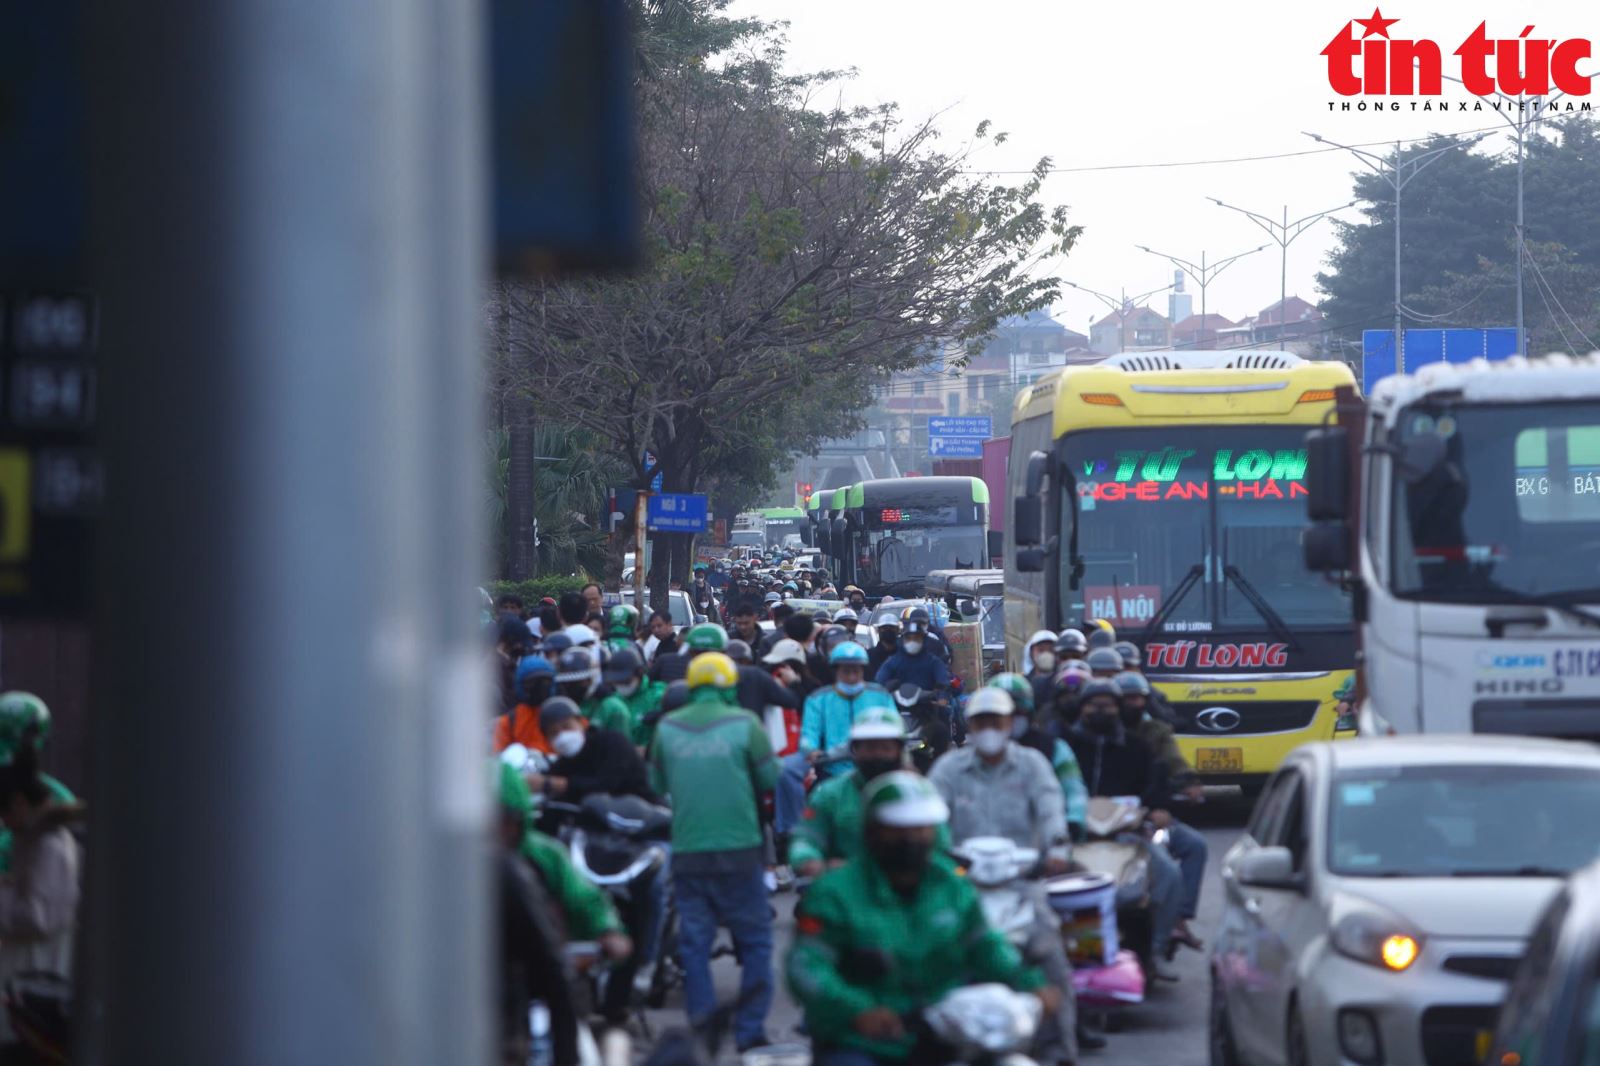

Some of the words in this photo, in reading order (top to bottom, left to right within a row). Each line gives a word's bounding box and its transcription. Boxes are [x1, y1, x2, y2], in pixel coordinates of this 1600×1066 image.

[1213, 449, 1309, 481] LON
[1164, 480, 1208, 500] AN
[1091, 594, 1117, 619] HÀ
[1121, 593, 1155, 622] NỘI
[1196, 641, 1289, 668] LONG
[1474, 678, 1564, 694] HINO
